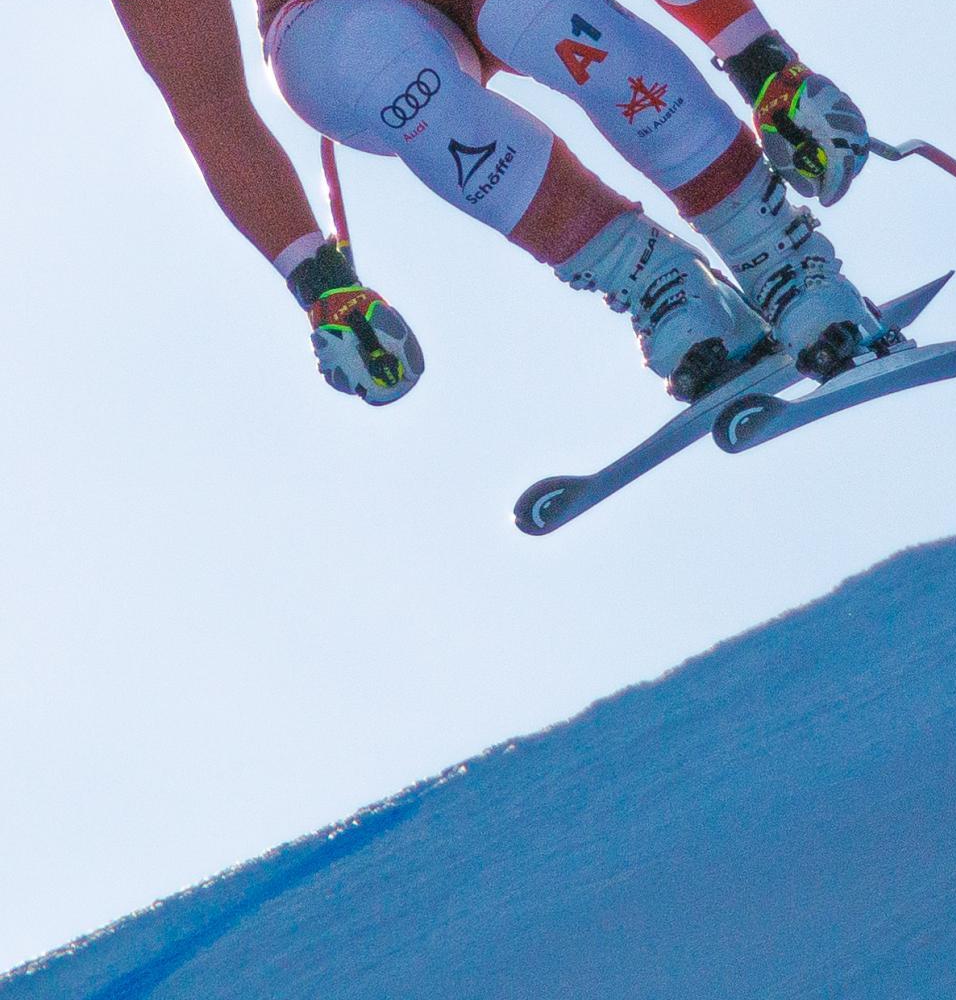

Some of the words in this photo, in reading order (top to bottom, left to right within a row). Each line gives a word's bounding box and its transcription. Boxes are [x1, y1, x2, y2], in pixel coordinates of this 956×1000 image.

[554, 13, 609, 86] A1
[403, 119, 429, 143] Audi
[636, 126, 652, 139] Ski
[653, 96, 685, 131] Austria
[465, 145, 517, 206] Schöffel
